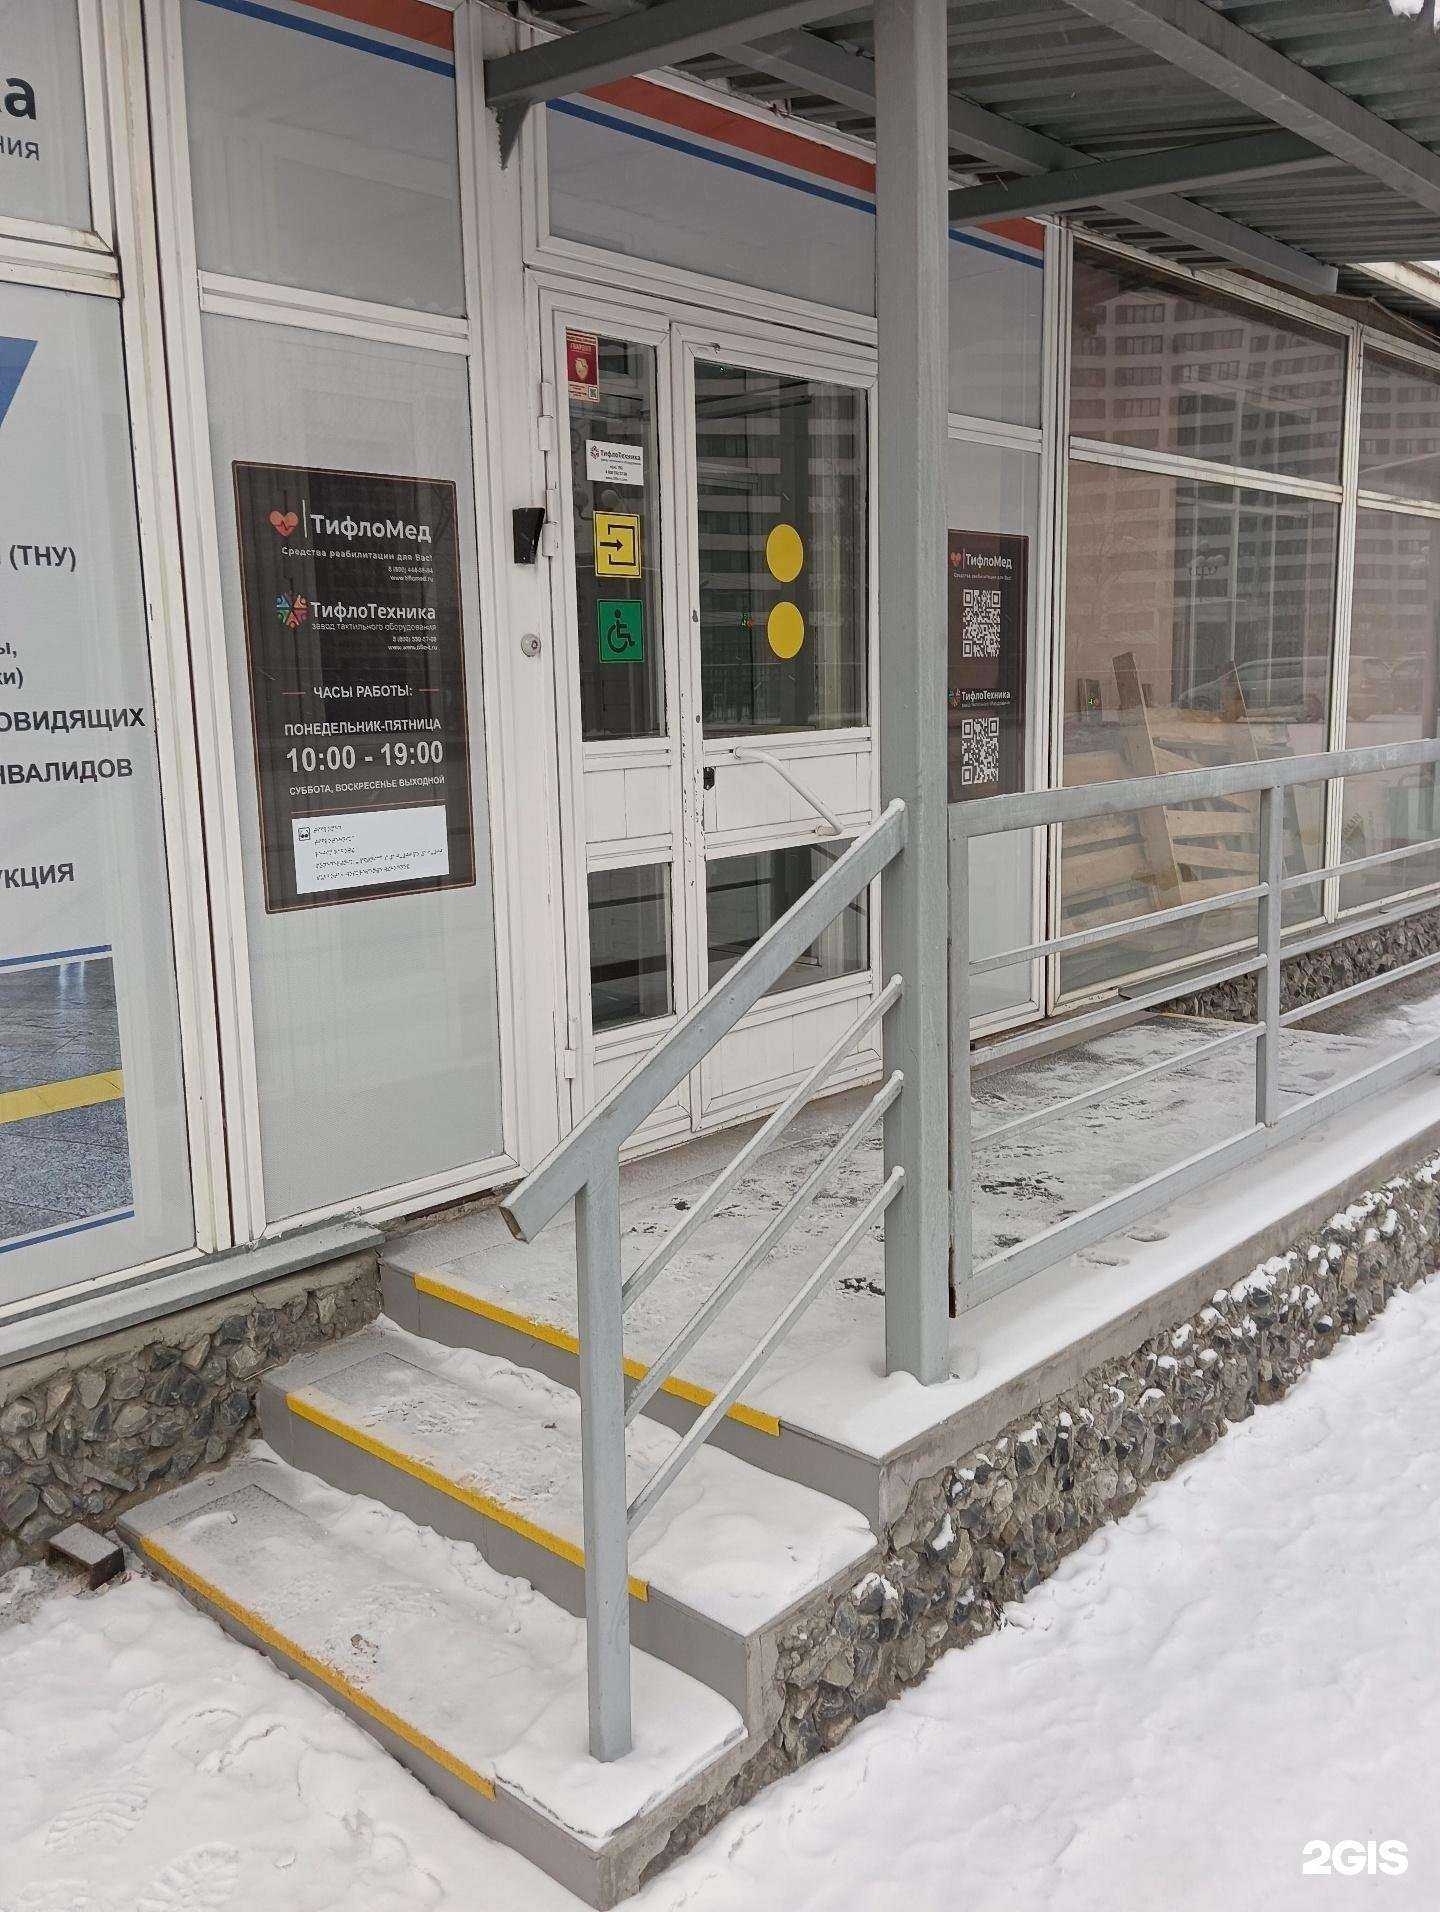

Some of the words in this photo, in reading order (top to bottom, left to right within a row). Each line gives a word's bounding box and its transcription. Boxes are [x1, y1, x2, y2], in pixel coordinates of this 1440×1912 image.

[310, 513, 432, 543] ТифлоМед
[10, 544, 76, 573] (ТНУ)
[281, 546, 327, 558] Средства
[965, 553, 1013, 569] ТифлоМед
[310, 602, 437, 622] ТифлоТехника
[313, 685, 353, 699] ЧАСЫ
[356, 684, 413, 698] РАБОТЫ:
[961, 690, 1011, 703] ТифлоТехника
[284, 718, 442, 737] ПОНЕДЕЛЬНИК-ПЯТНИЦА
[286, 745, 356, 773] 10:00
[380, 740, 443, 766] 19:00
[289, 783, 334, 796] СУББОТА,
[335, 779, 398, 793] ВОСКРЕСЕНЬЕ
[399, 774, 445, 788] ВЫХОДНОЙ
[0, 861, 75, 890] КЦИЯ
